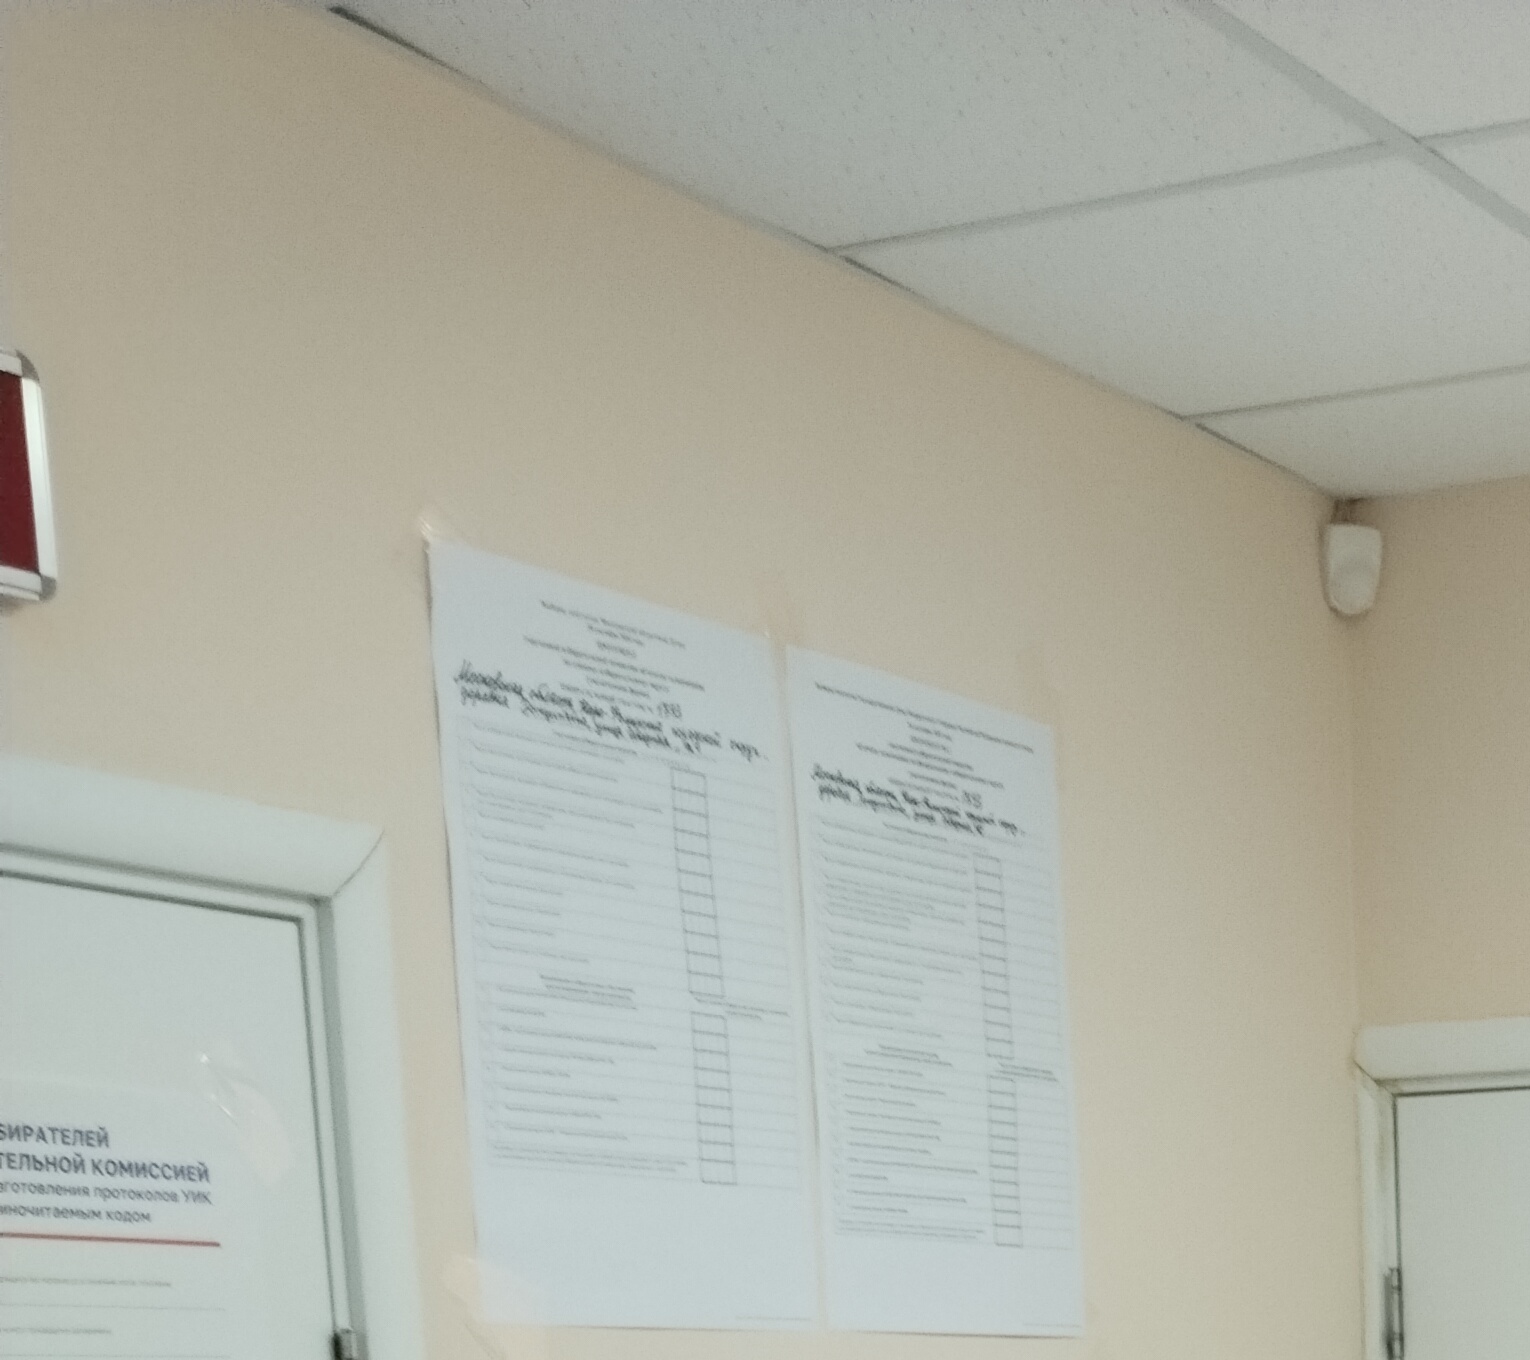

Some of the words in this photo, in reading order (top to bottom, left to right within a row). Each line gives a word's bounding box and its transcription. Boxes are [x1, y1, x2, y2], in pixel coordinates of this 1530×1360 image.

[91, 1158, 209, 1183] КОМИССИЕЙ
[93, 1186, 179, 1203] протоколов
[181, 1189, 213, 1204] УИК
[105, 1210, 152, 1224] кодом
